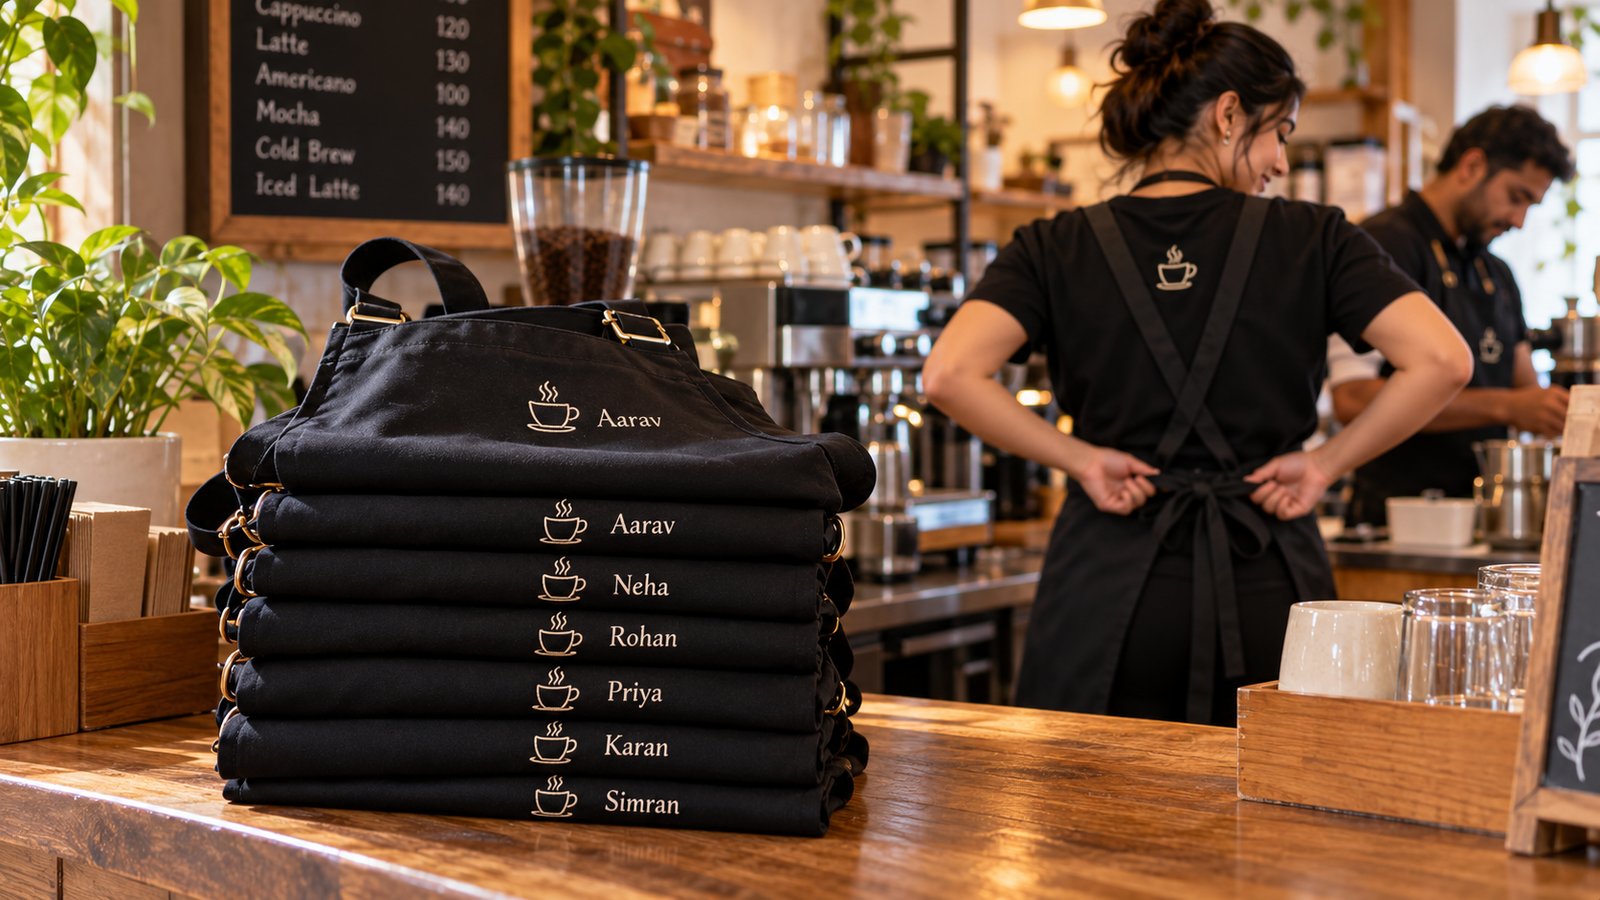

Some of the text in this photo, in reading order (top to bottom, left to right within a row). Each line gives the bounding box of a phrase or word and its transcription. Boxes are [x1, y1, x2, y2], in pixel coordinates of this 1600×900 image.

[255, 0, 470, 40] Cappuccino 120
[256, 27, 470, 73] Latte 130
[255, 63, 470, 106] Americano 100
[256, 99, 470, 139] Mocha 140
[255, 136, 470, 172] Cold Brew 150
[256, 172, 470, 206] Iced Latte 140
[597, 409, 661, 428] Aarav
[610, 513, 675, 535] Aarav
[613, 573, 669, 596] Neha
[609, 625, 677, 648] Rohan
[607, 680, 663, 708] Priya
[604, 734, 669, 757] Karan
[605, 789, 680, 814] Simran
